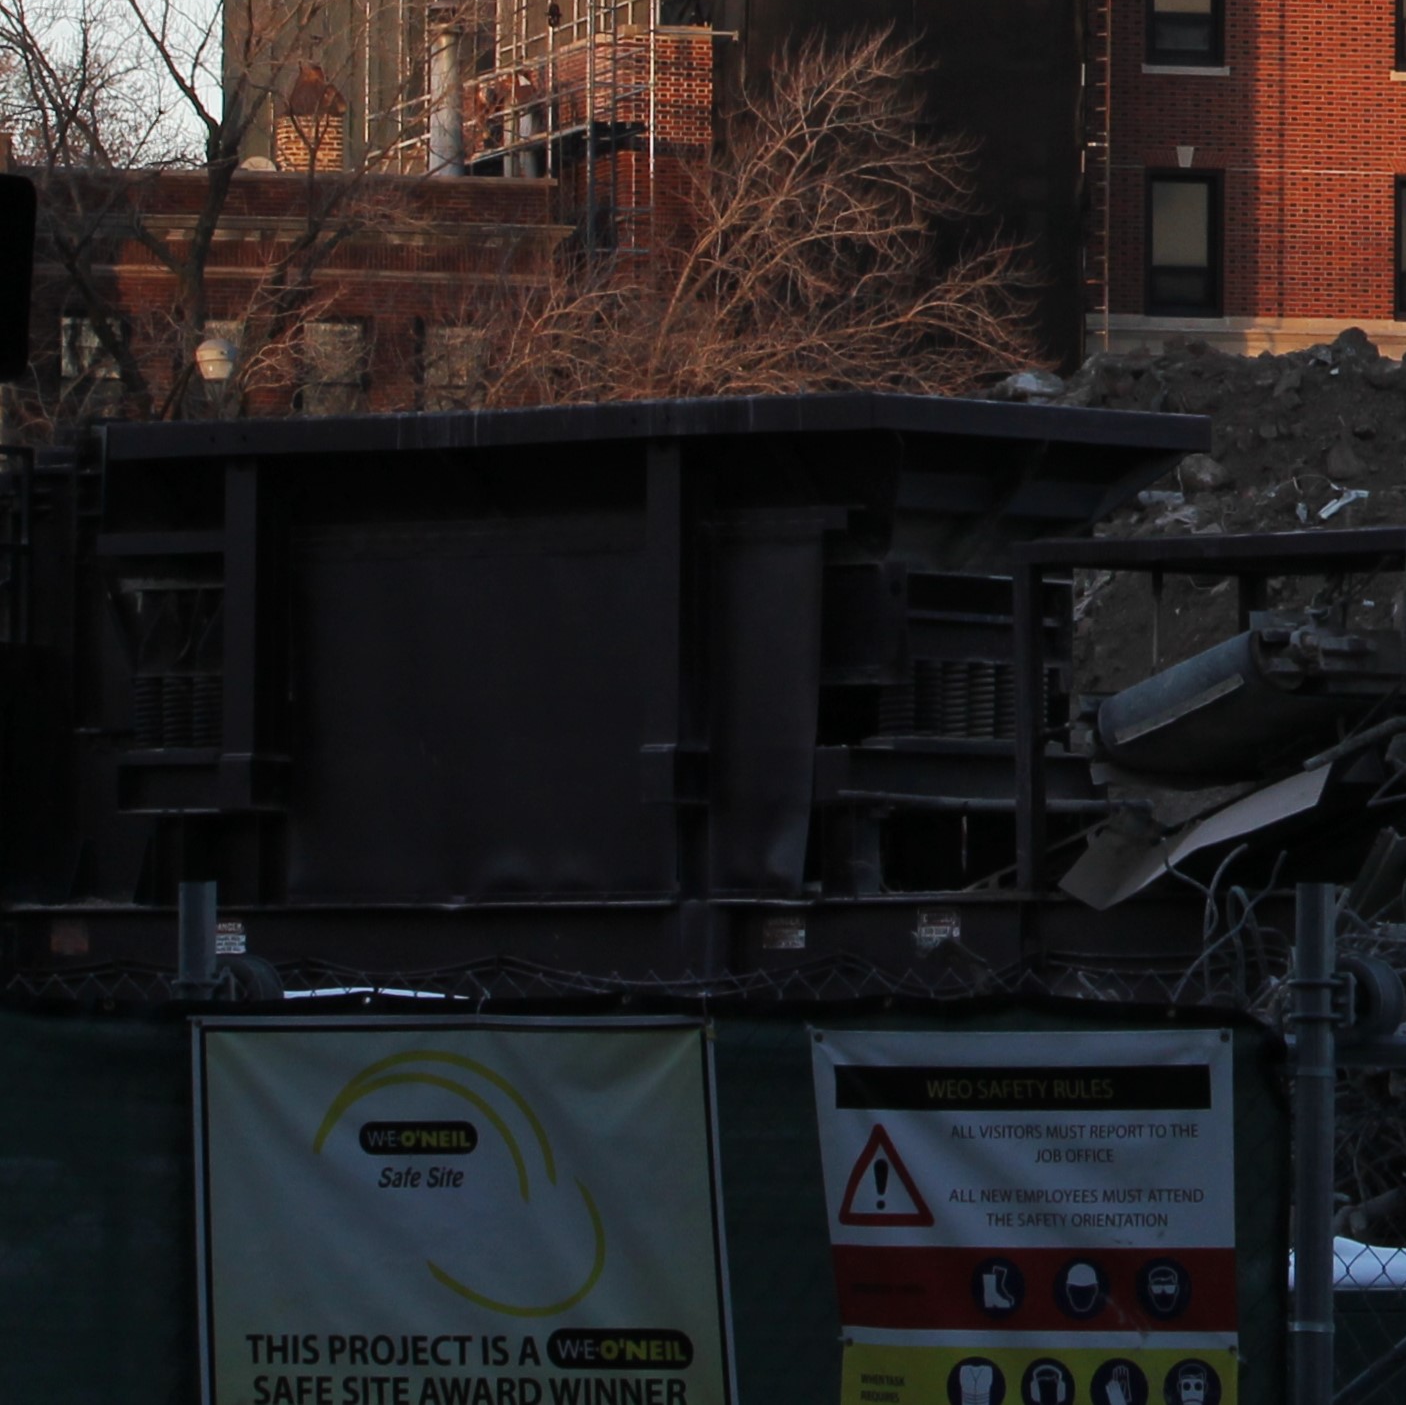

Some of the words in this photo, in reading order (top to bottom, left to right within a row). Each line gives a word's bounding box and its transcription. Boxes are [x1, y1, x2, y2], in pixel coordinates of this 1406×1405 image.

[925, 1080, 973, 1099] WEO
[977, 1079, 1048, 1099] SAFETY
[1053, 1078, 1114, 1099] RULES
[951, 1125, 975, 1139] ALL
[979, 1124, 1042, 1139] VISITORS
[1046, 1124, 1086, 1139] MUST
[1090, 1124, 1143, 1139] REPORT
[1147, 1124, 1166, 1138] TO
[1170, 1124, 1198, 1138] THE
[1034, 1149, 1062, 1163] JOB
[1066, 1149, 1114, 1163] OFFICE
[378, 1167, 421, 1188] Safe
[426, 1167, 464, 1188] Site
[948, 1189, 976, 1203] ALL
[980, 1189, 1012, 1203] NEW
[1016, 1189, 1098, 1203] EMPLOYEES
[1102, 1189, 1142, 1203] MUST
[1147, 1188, 1204, 1203] ATTEND
[986, 1213, 1014, 1227] THE
[1018, 1213, 1068, 1228] SAFETY
[1071, 1213, 1168, 1228] ORIENTATION
[246, 1335, 319, 1365] THIS
[329, 1335, 472, 1366] PROJECT
[482, 1336, 509, 1366] IS
[518, 1336, 541, 1366] A
[254, 1376, 332, 1405] SAFE
[342, 1377, 410, 1405] SITE
[419, 1378, 542, 1405] AWARD
[549, 1379, 687, 1405] WINNER
